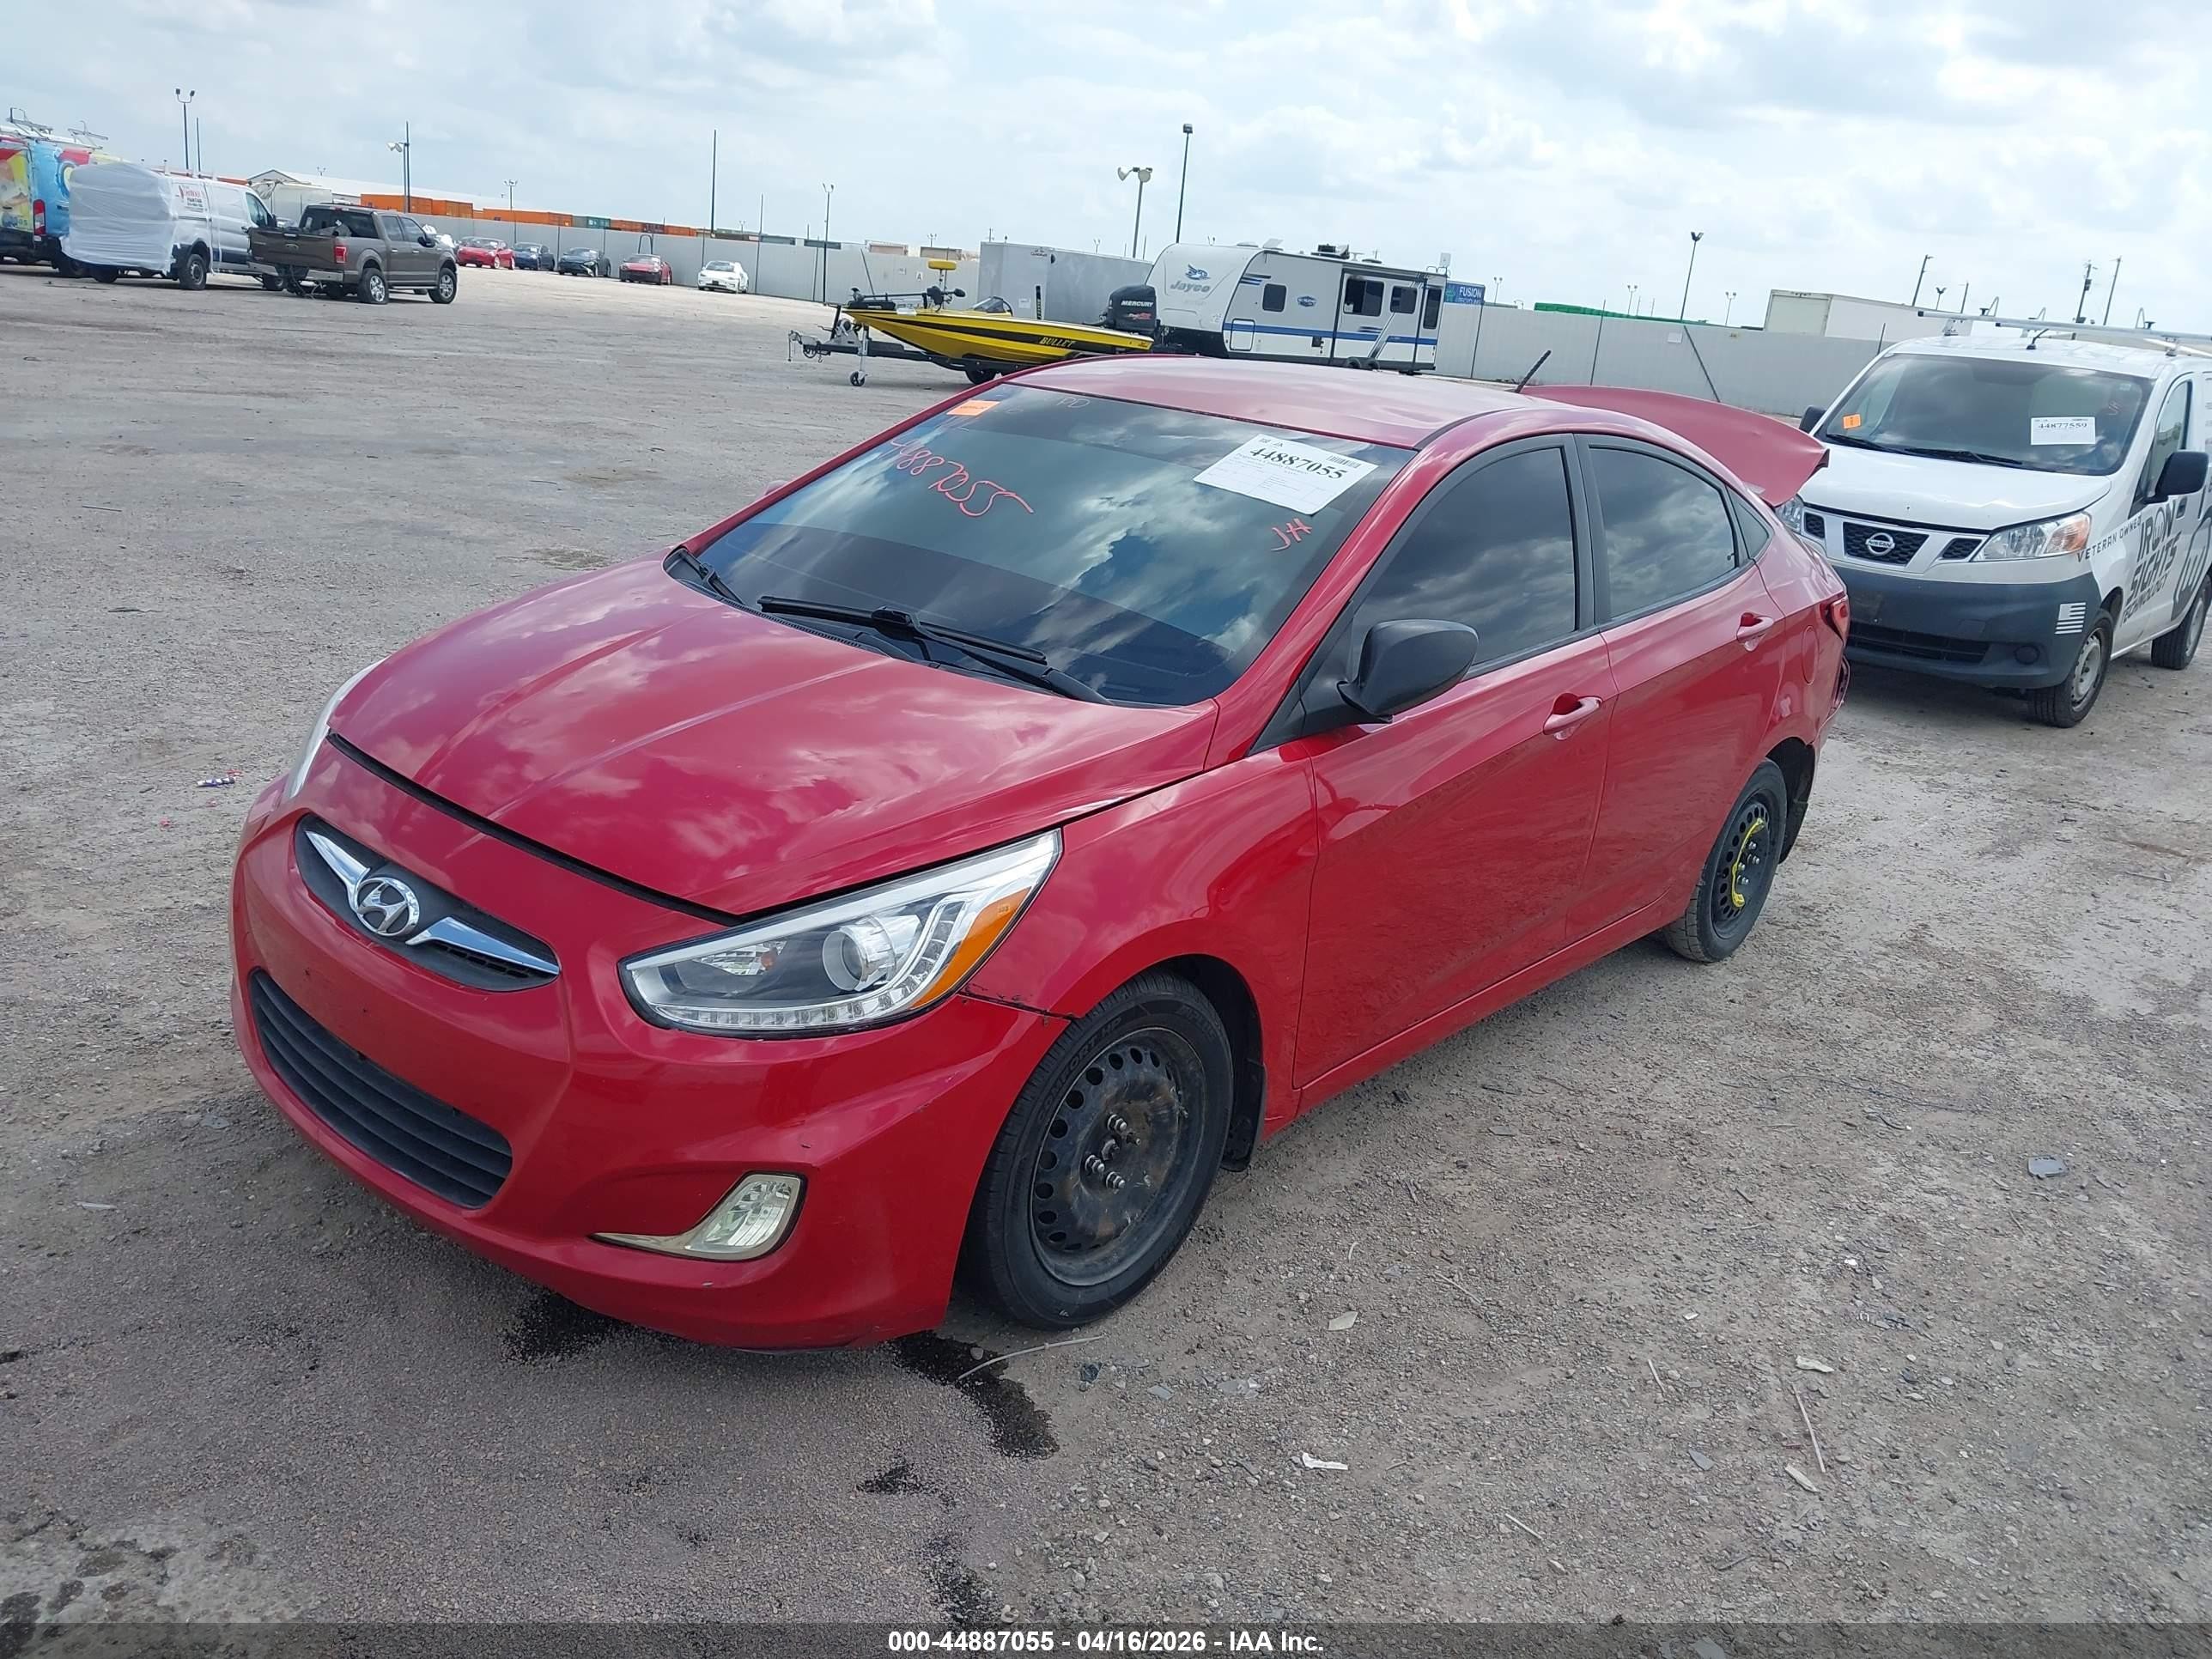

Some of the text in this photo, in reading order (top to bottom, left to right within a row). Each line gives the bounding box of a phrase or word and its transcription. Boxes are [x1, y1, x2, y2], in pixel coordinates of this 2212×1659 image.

[1170, 281, 1212, 293] Jayco
[1458, 286, 1482, 298] FUSION
[1039, 337, 1076, 348] BULLET
[1249, 447, 1347, 480] 44887055
[2076, 515, 2143, 563] VETERAN OWNED
[2136, 500, 2176, 563] IRON
[2124, 531, 2182, 608] SIGHTS
